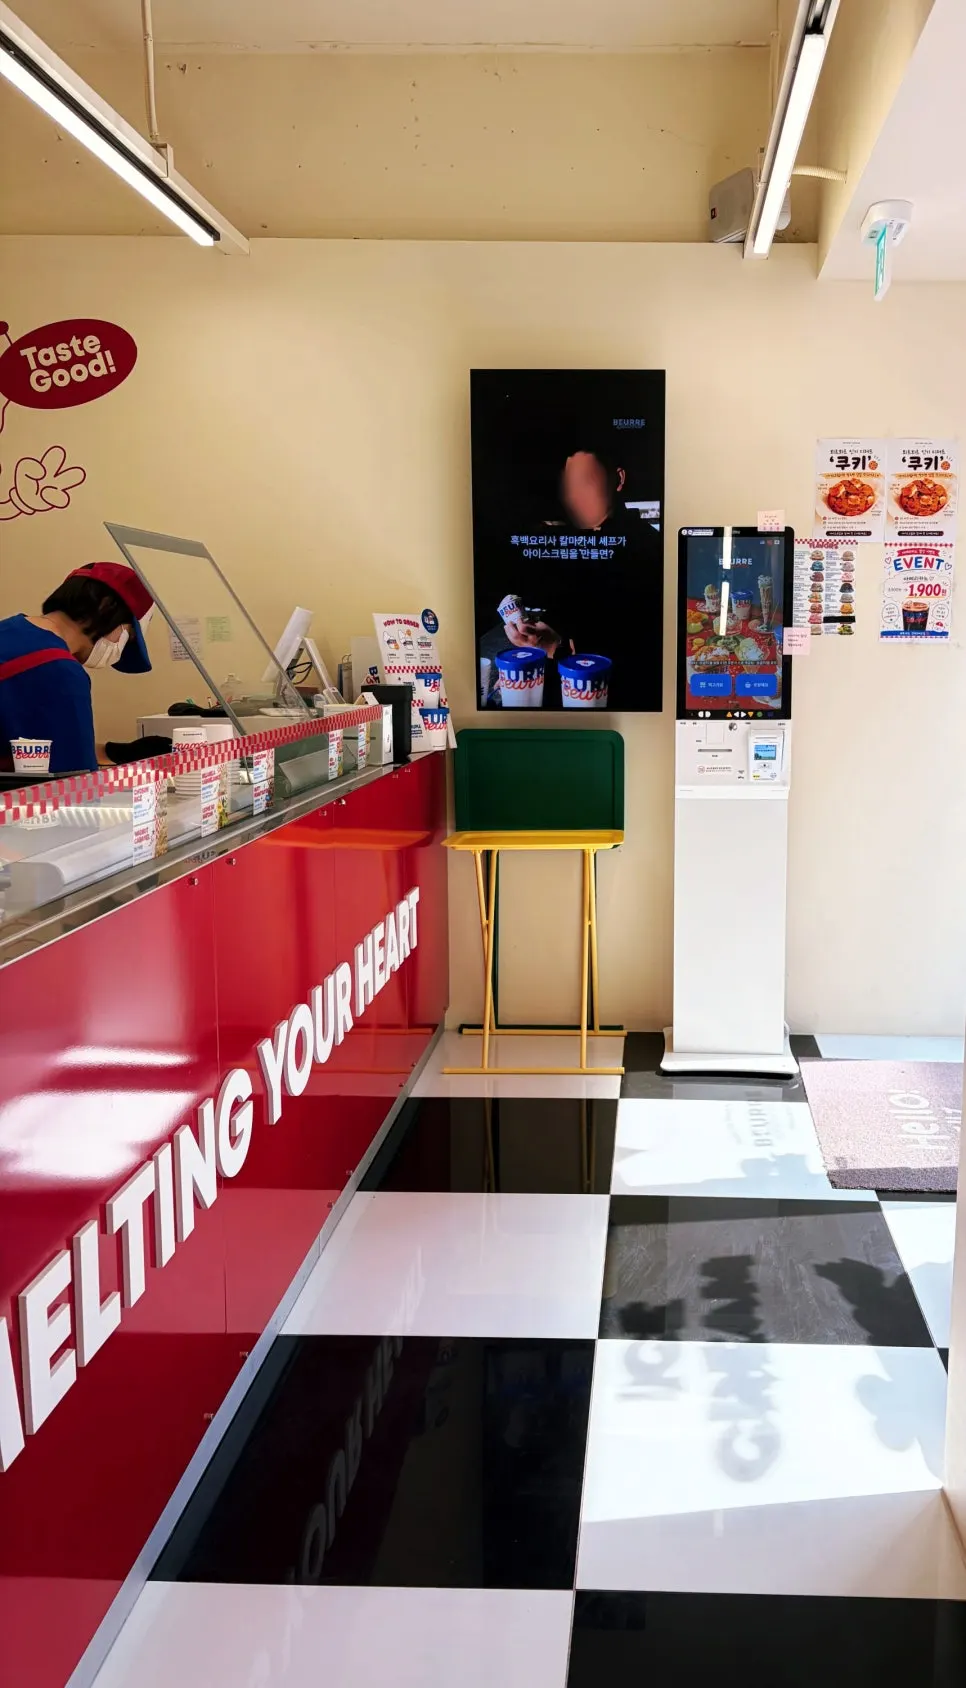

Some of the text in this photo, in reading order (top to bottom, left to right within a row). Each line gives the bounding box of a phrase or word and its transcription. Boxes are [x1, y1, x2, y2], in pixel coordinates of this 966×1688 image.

[20, 335, 101, 370] Taste
[30, 350, 117, 393] Good!
[510, 535, 557, 547] 흑백요리사
[522, 549, 614, 560] 아이스크림을 만들면?
[893, 556, 944, 572] EVENT
[0, 886, 420, 1472] ELTING YOUR HEART
